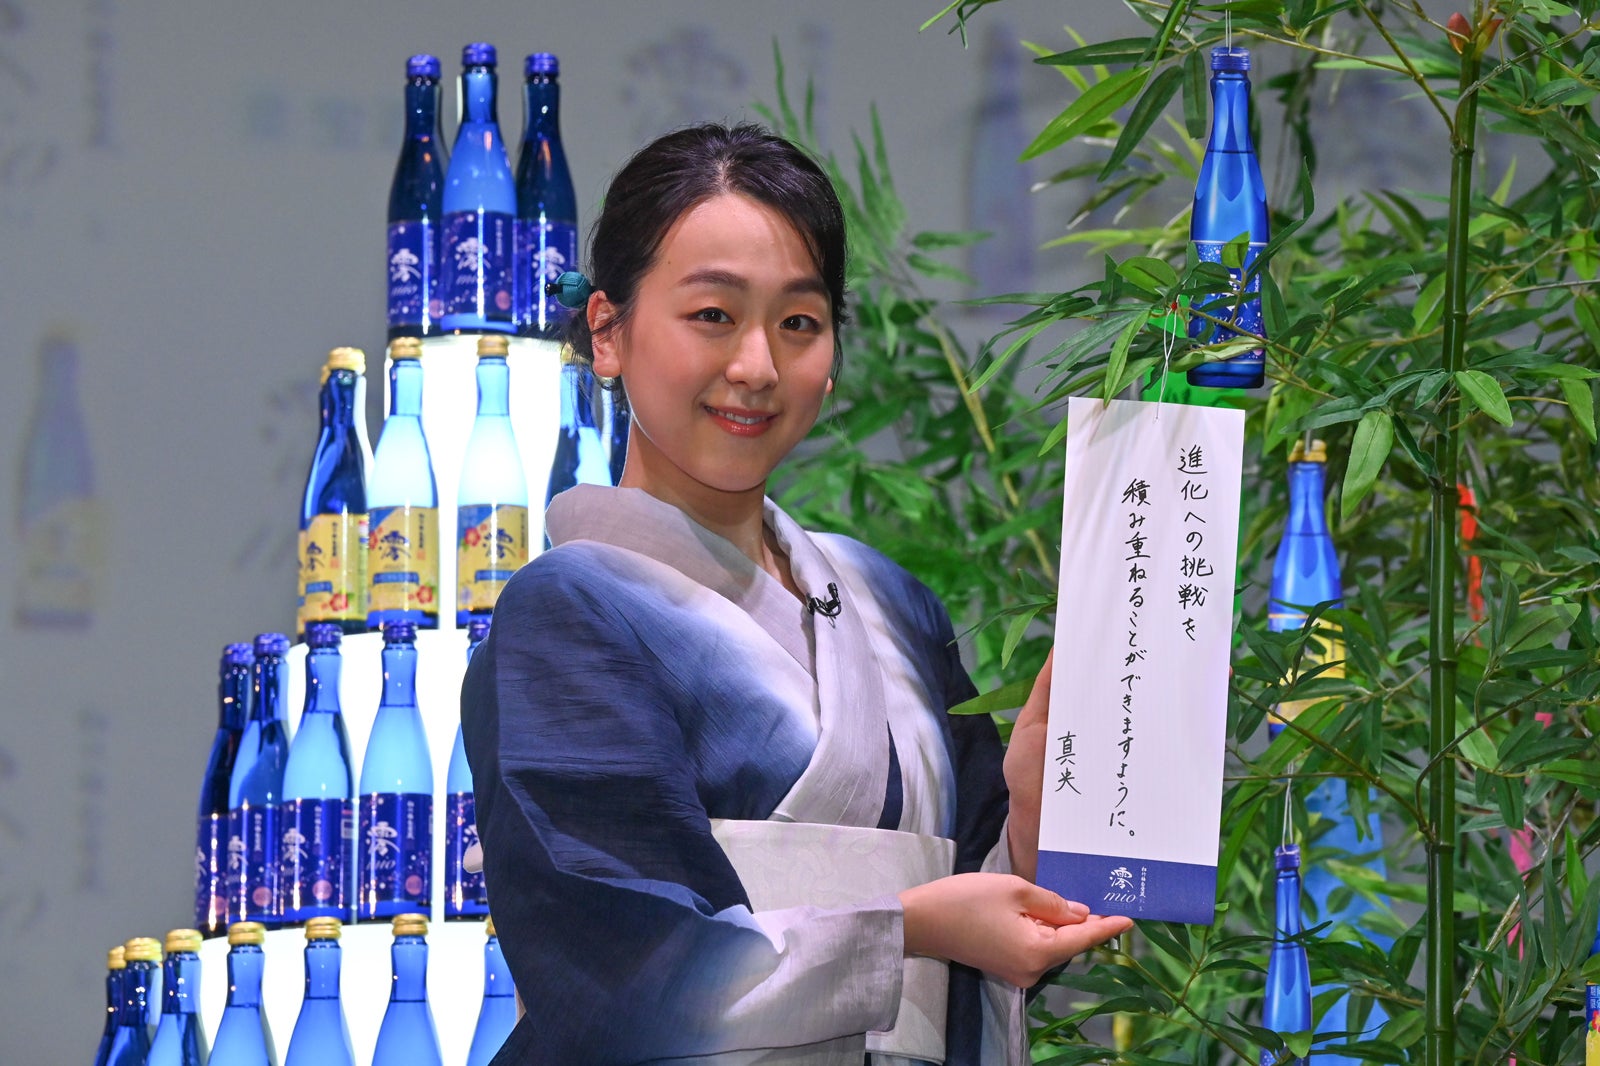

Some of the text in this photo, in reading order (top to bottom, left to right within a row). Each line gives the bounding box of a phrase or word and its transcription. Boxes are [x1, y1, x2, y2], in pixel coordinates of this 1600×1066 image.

[1177, 444, 1214, 641] 進化への挑戦を
[1108, 478, 1151, 837] 積み重ねることができますように。
[1054, 731, 1082, 795] 真央
[1103, 889, 1137, 903] mio
[1109, 866, 1134, 890] 澪
